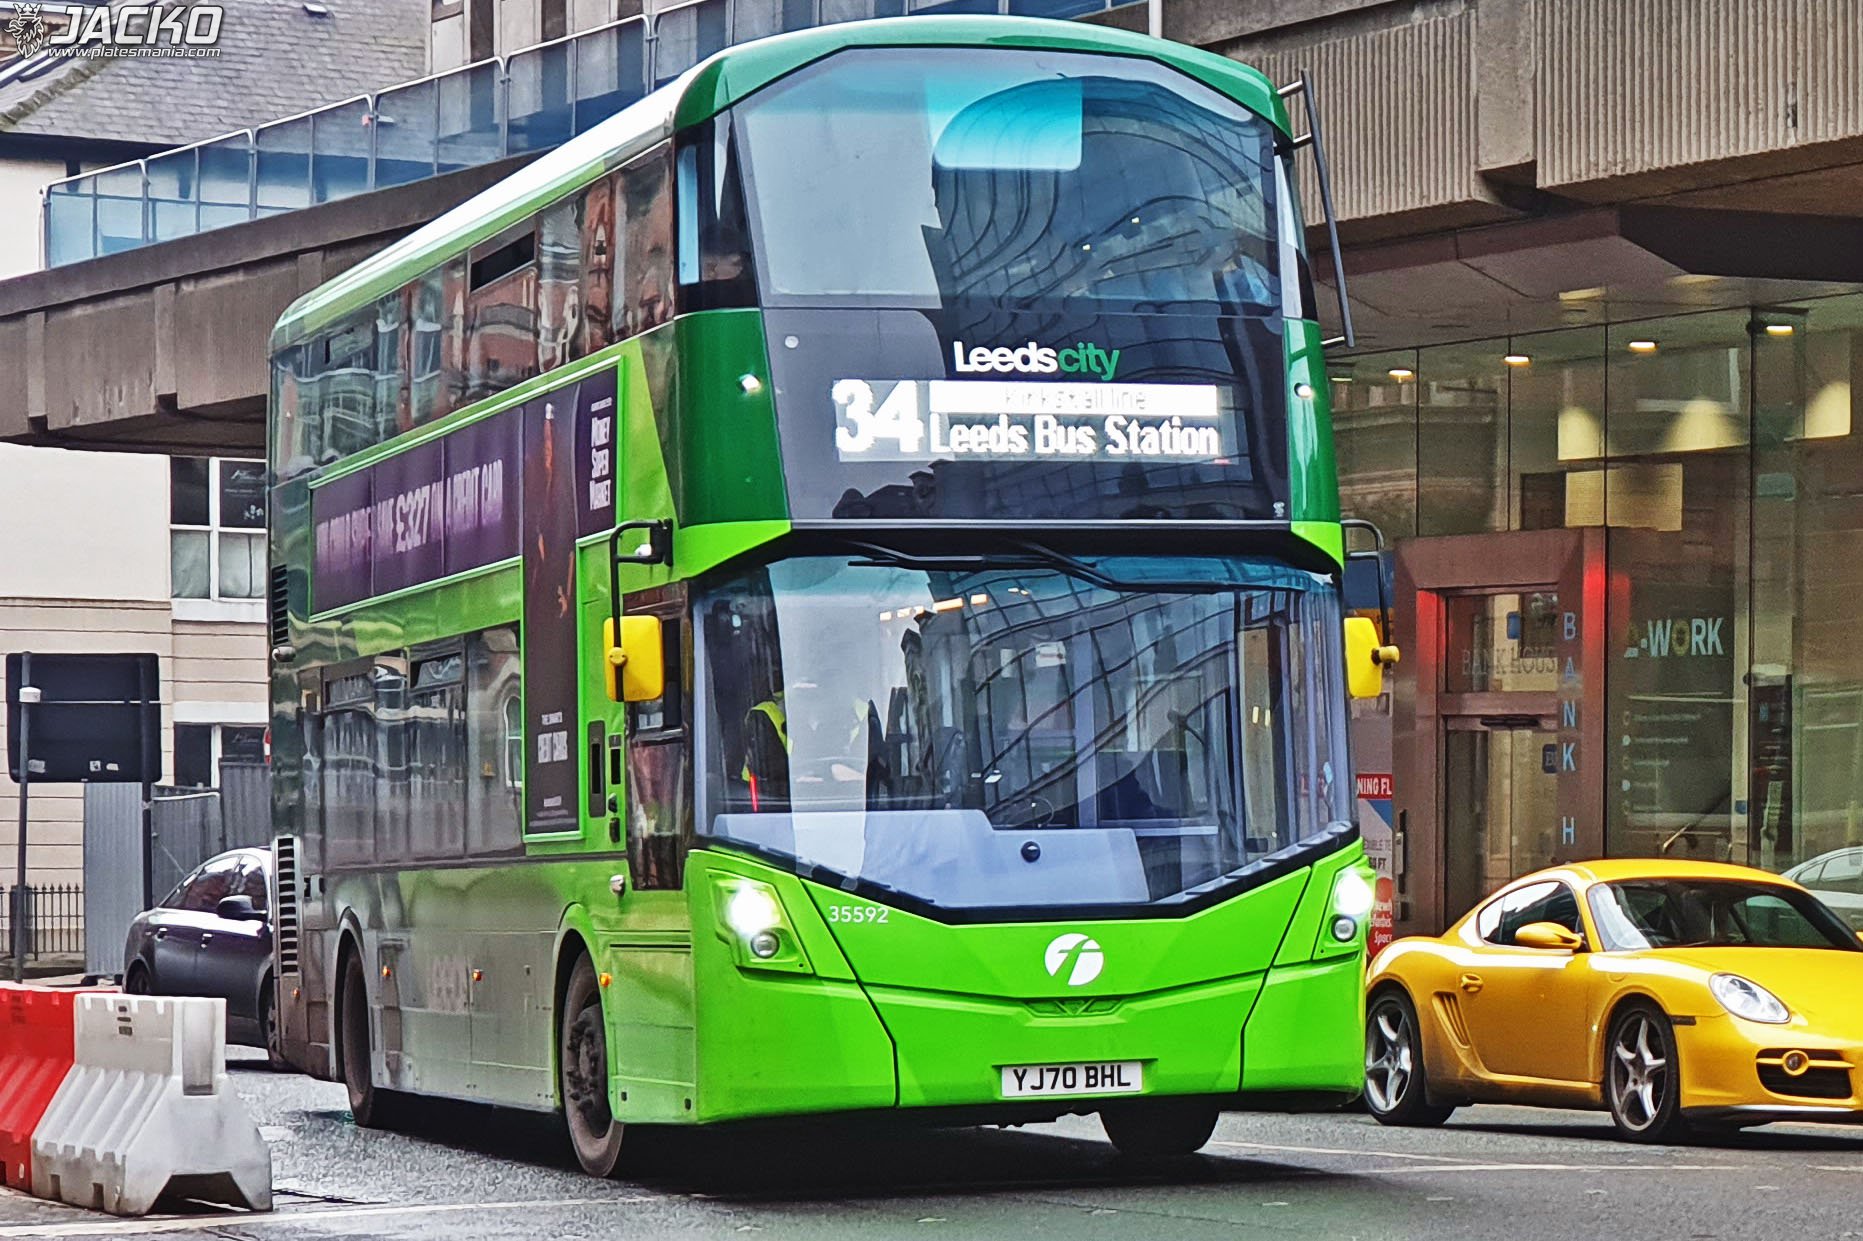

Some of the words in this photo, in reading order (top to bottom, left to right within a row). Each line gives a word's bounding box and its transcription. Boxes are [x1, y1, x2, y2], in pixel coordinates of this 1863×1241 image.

[953, 341, 1120, 381] Leedscity
[832, 378, 924, 453] 34
[930, 413, 1027, 454] Leeds
[1036, 415, 1095, 454] Bus
[1106, 416, 1219, 456] Station
[396, 487, 430, 552] £327
[829, 906, 889, 924] 35592
[1012, 1066, 1080, 1093] YJ70
[1084, 1064, 1131, 1089] BHL
